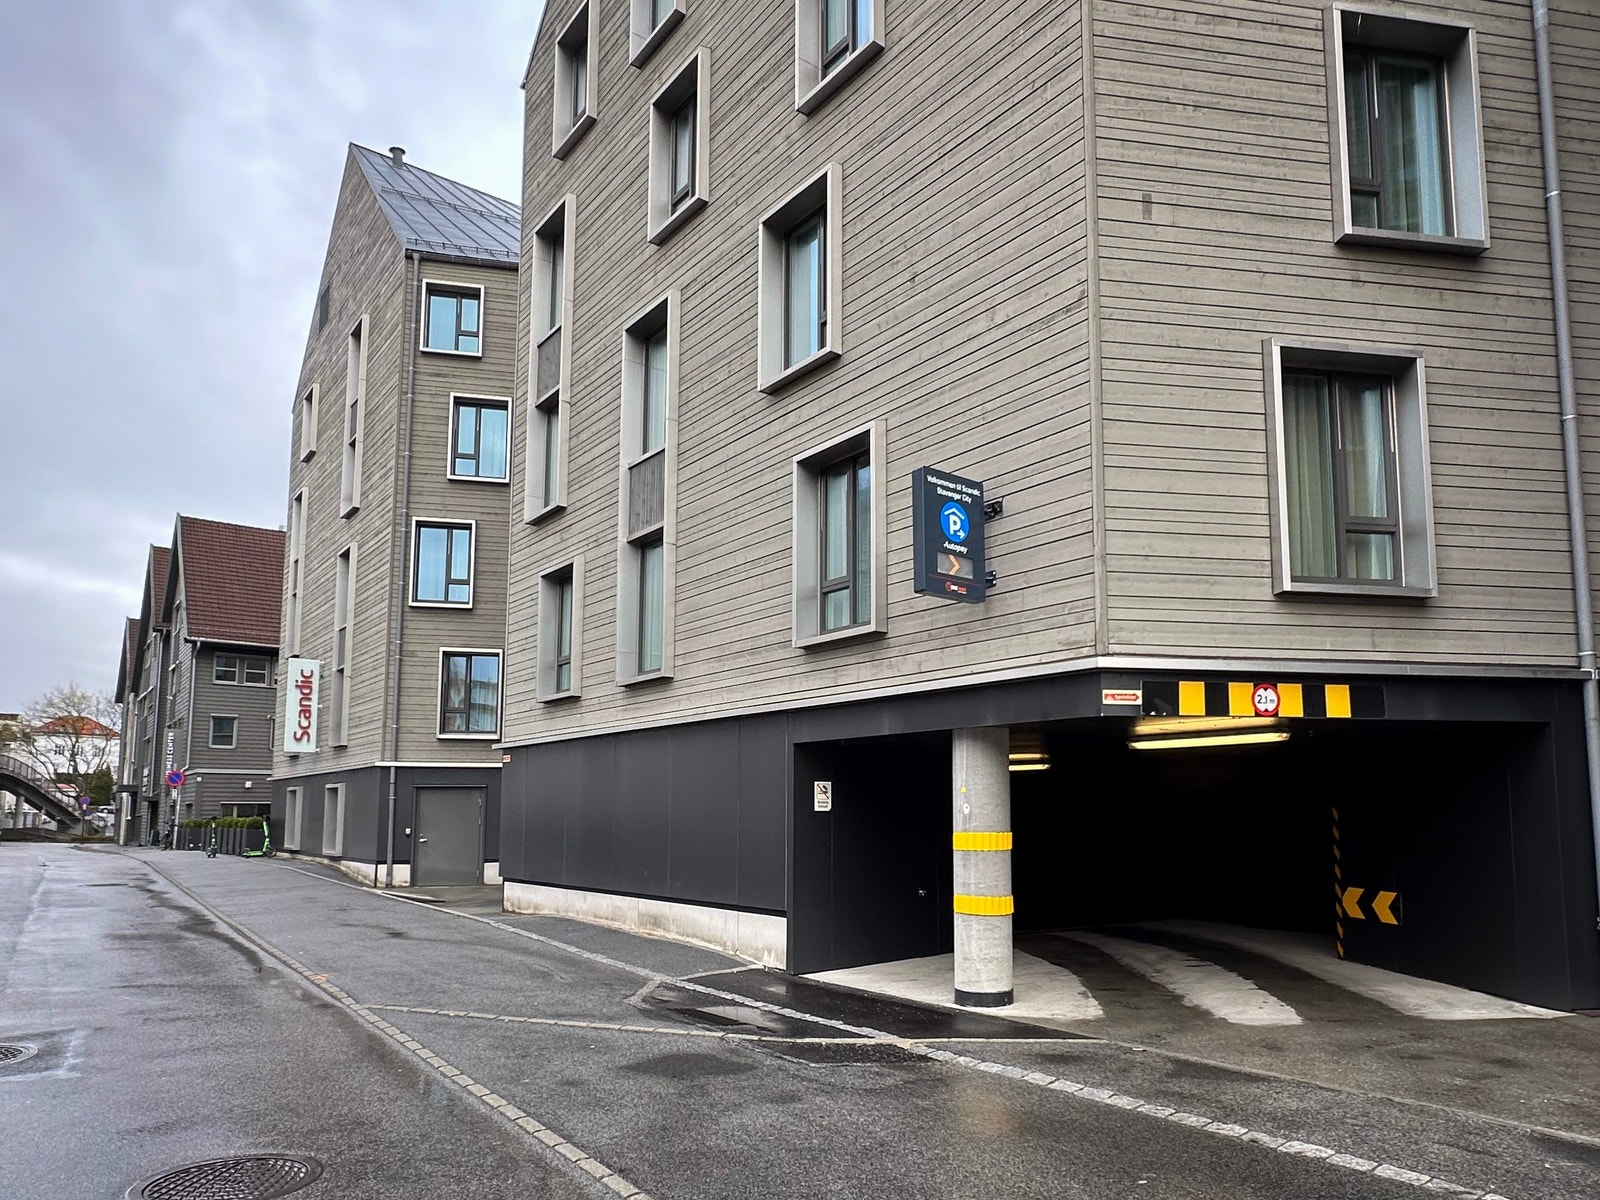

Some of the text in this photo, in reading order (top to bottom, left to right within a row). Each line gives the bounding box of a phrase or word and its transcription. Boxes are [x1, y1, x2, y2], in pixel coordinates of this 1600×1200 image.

[949, 514, 962, 535] P
[943, 541, 968, 555] Autopay
[293, 668, 314, 744] Scandic
